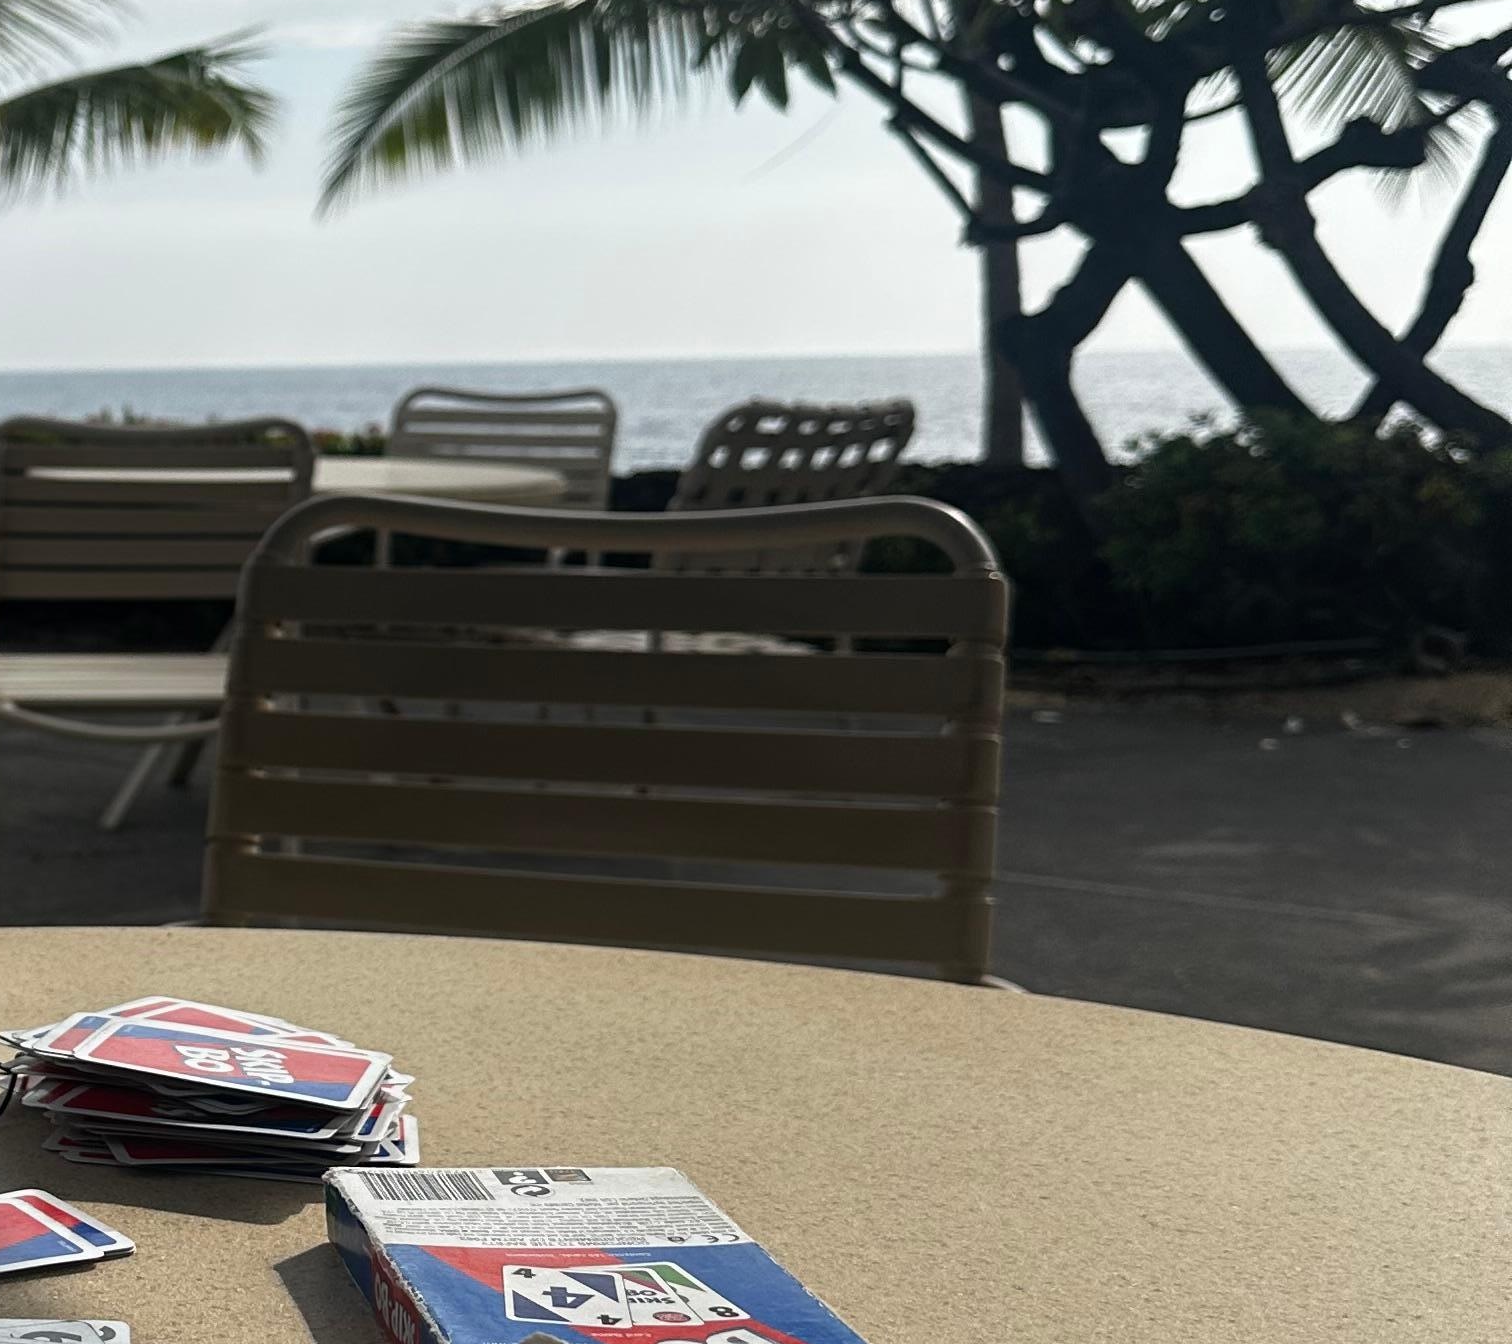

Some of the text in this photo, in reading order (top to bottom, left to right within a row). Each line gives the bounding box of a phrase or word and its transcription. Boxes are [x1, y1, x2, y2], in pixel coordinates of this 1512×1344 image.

[541, 1286, 595, 1310] 4
[708, 1306, 740, 1318] 8
[595, 1314, 623, 1326] 4
